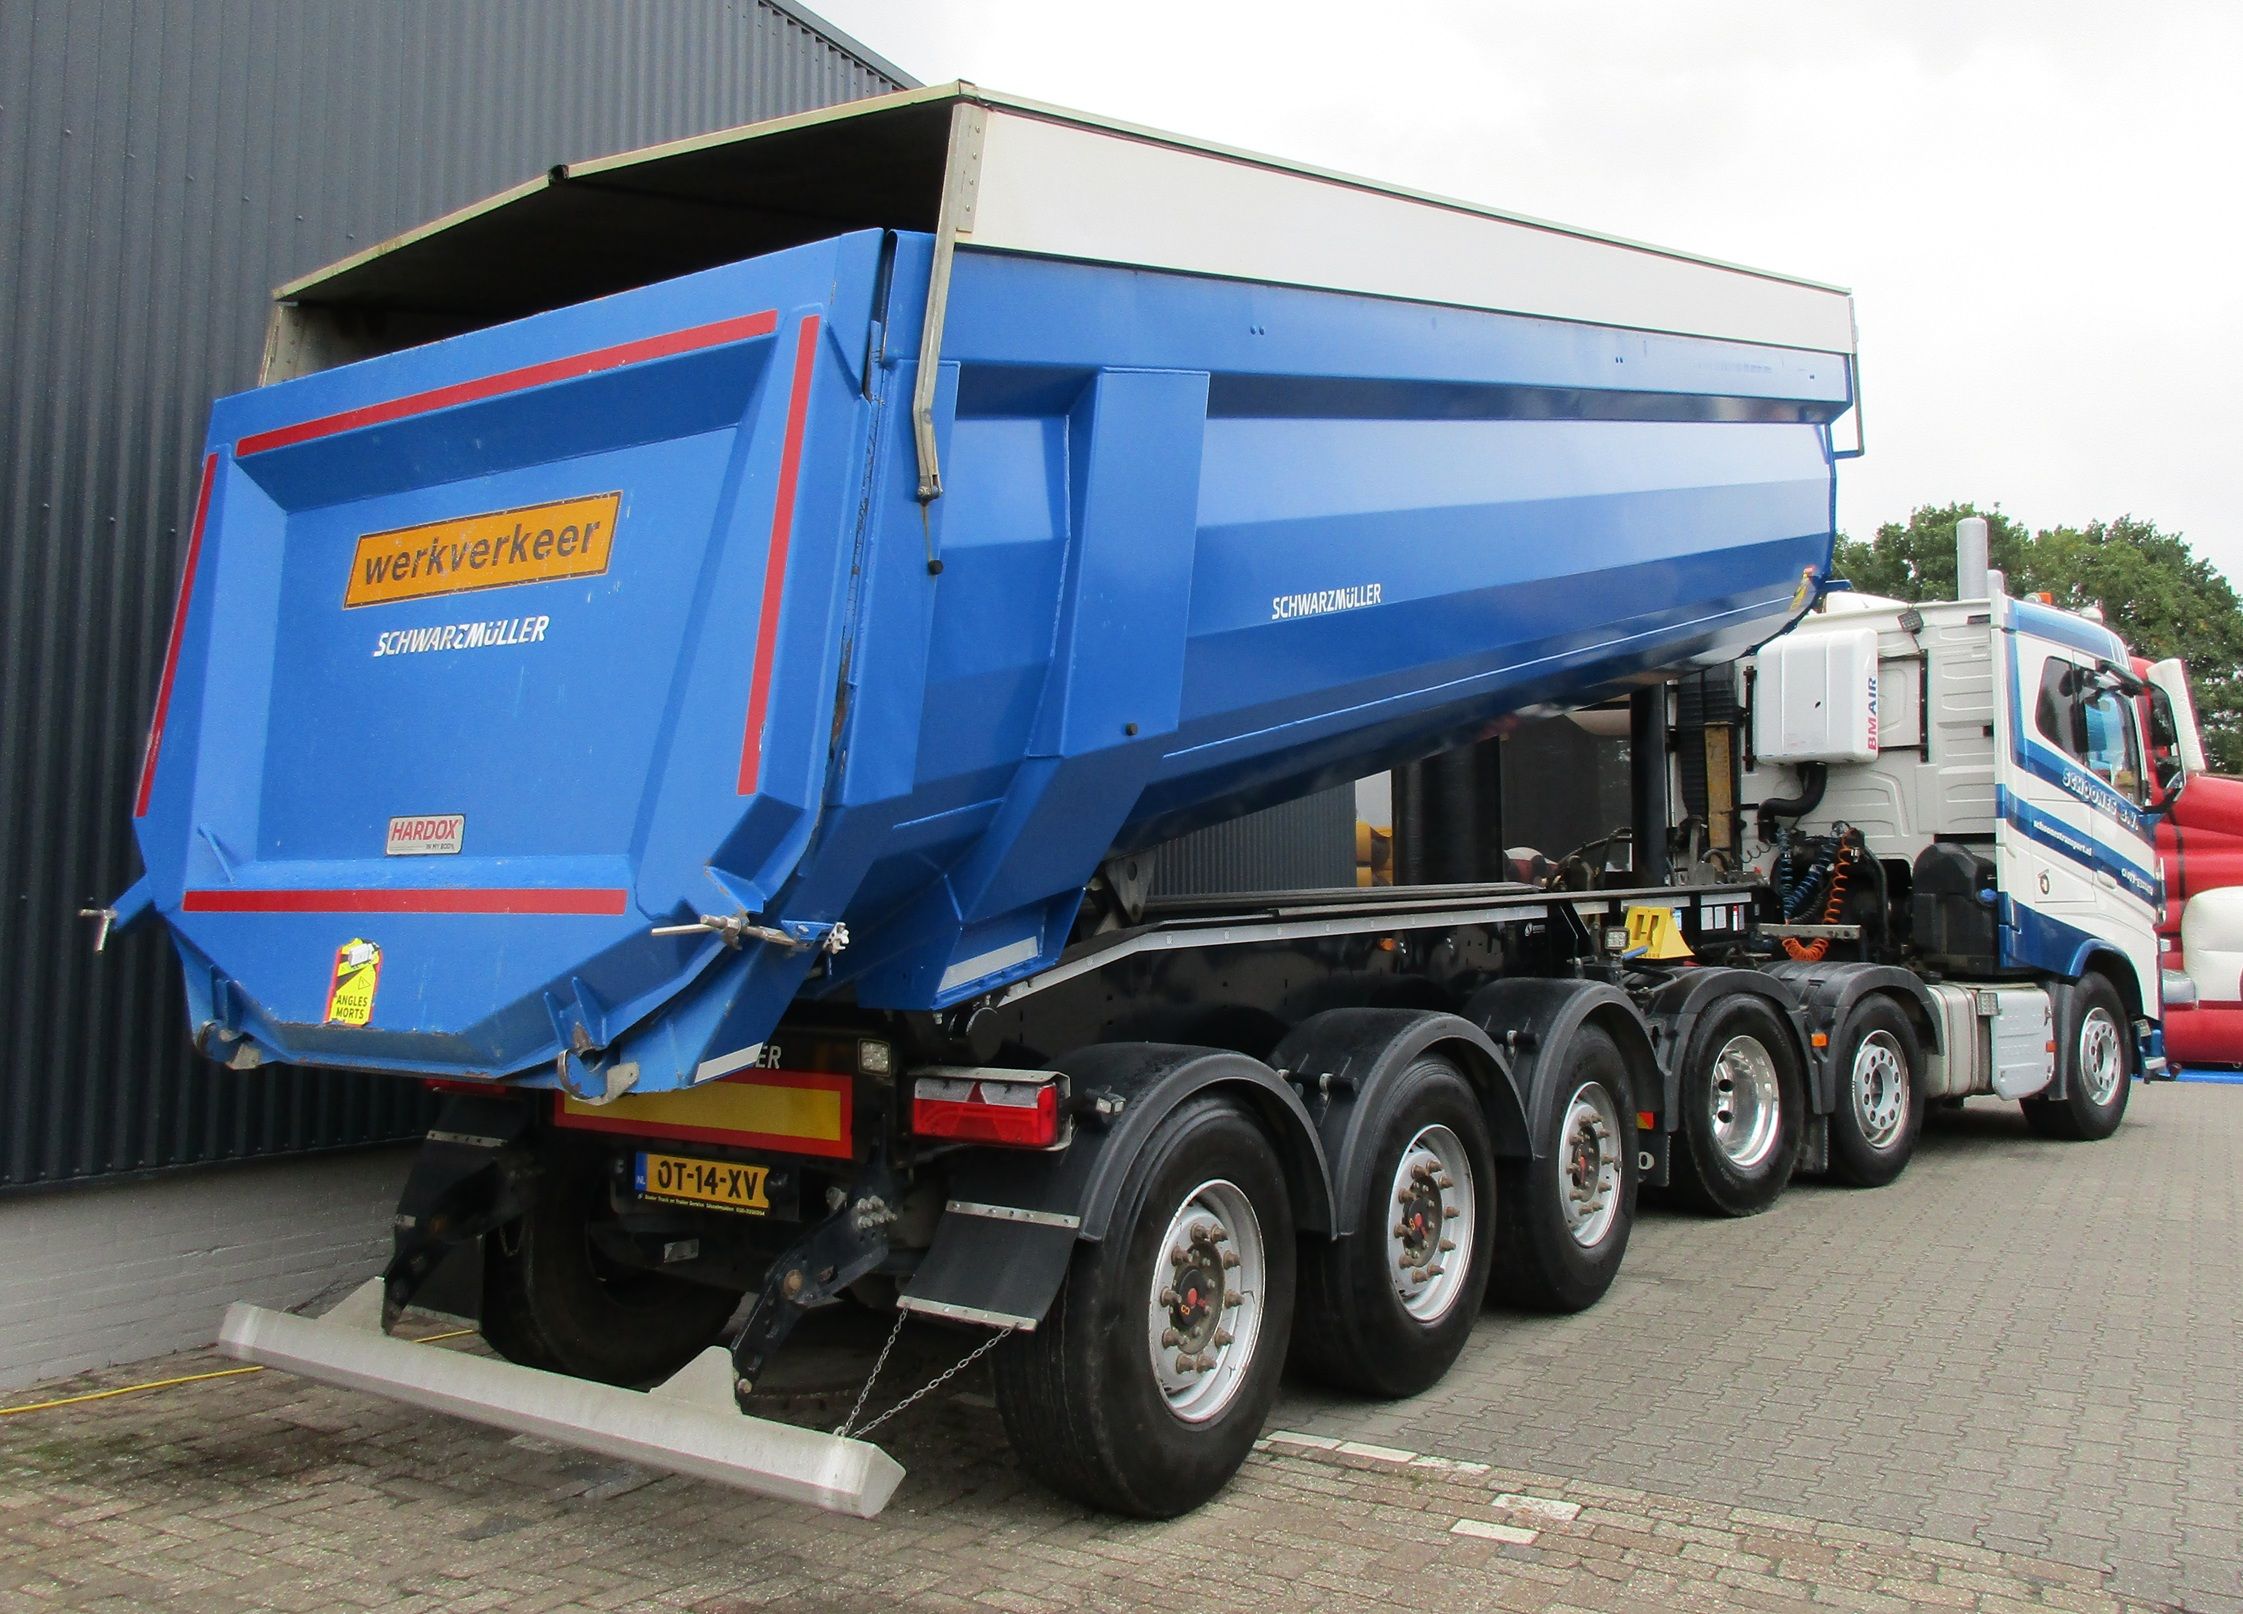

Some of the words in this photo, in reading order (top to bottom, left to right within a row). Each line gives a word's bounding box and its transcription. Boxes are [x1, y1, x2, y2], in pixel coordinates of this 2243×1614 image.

[365, 521, 600, 586] werkverkeer
[391, 820, 459, 841] HARDOX
[336, 994, 369, 1008] ANGLES
[335, 1007, 365, 1020] MORTS
[637, 1175, 646, 1185] NL
